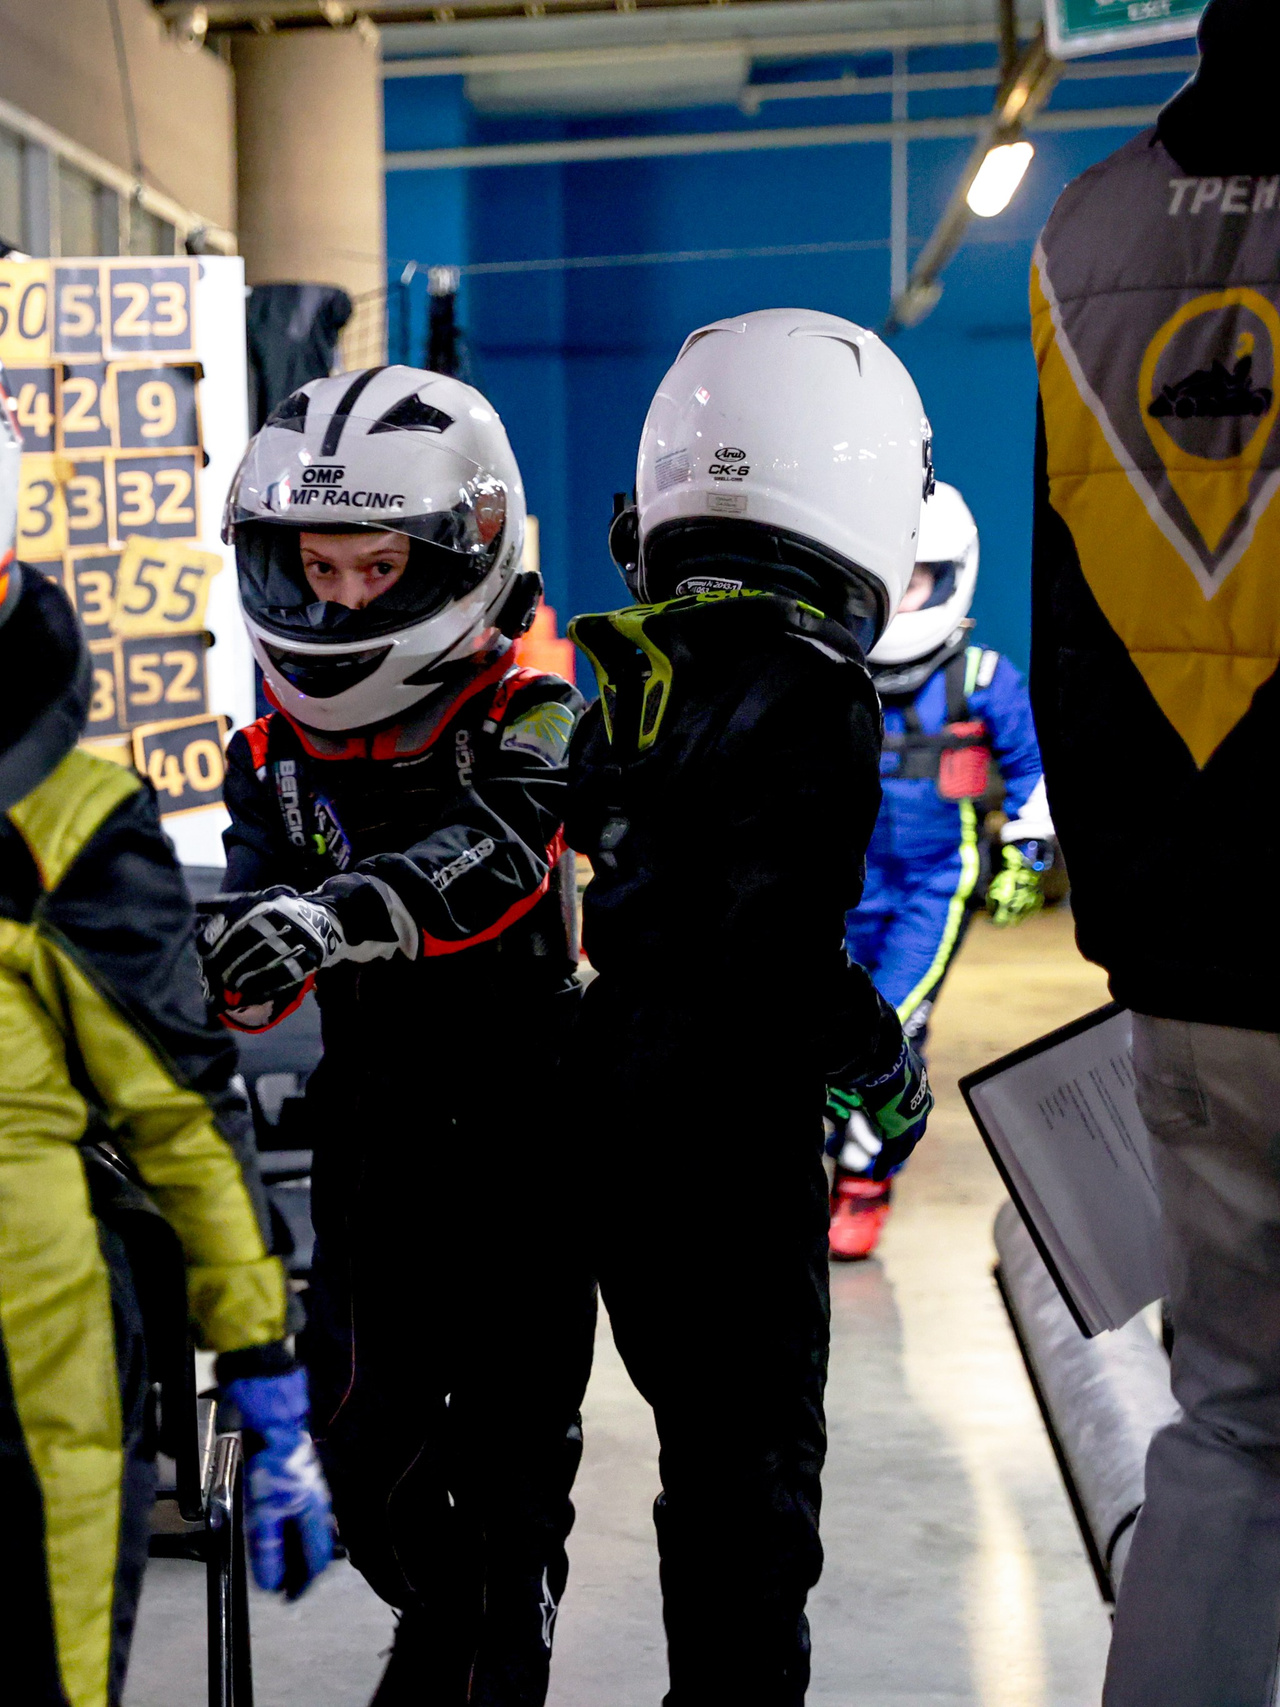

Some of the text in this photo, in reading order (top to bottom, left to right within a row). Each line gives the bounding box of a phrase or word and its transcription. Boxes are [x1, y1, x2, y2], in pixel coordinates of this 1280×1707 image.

[1168, 175, 1280, 215] ТРЕН
[59, 284, 102, 337] 5
[112, 281, 188, 337] 23
[136, 381, 176, 437] 9
[117, 469, 195, 526] 32
[302, 468, 345, 484] OMP
[708, 464, 751, 476] CK-6
[286, 489, 406, 508] MP RACING
[123, 556, 205, 622] 55
[129, 650, 203, 706] 52
[149, 739, 224, 798] 40
